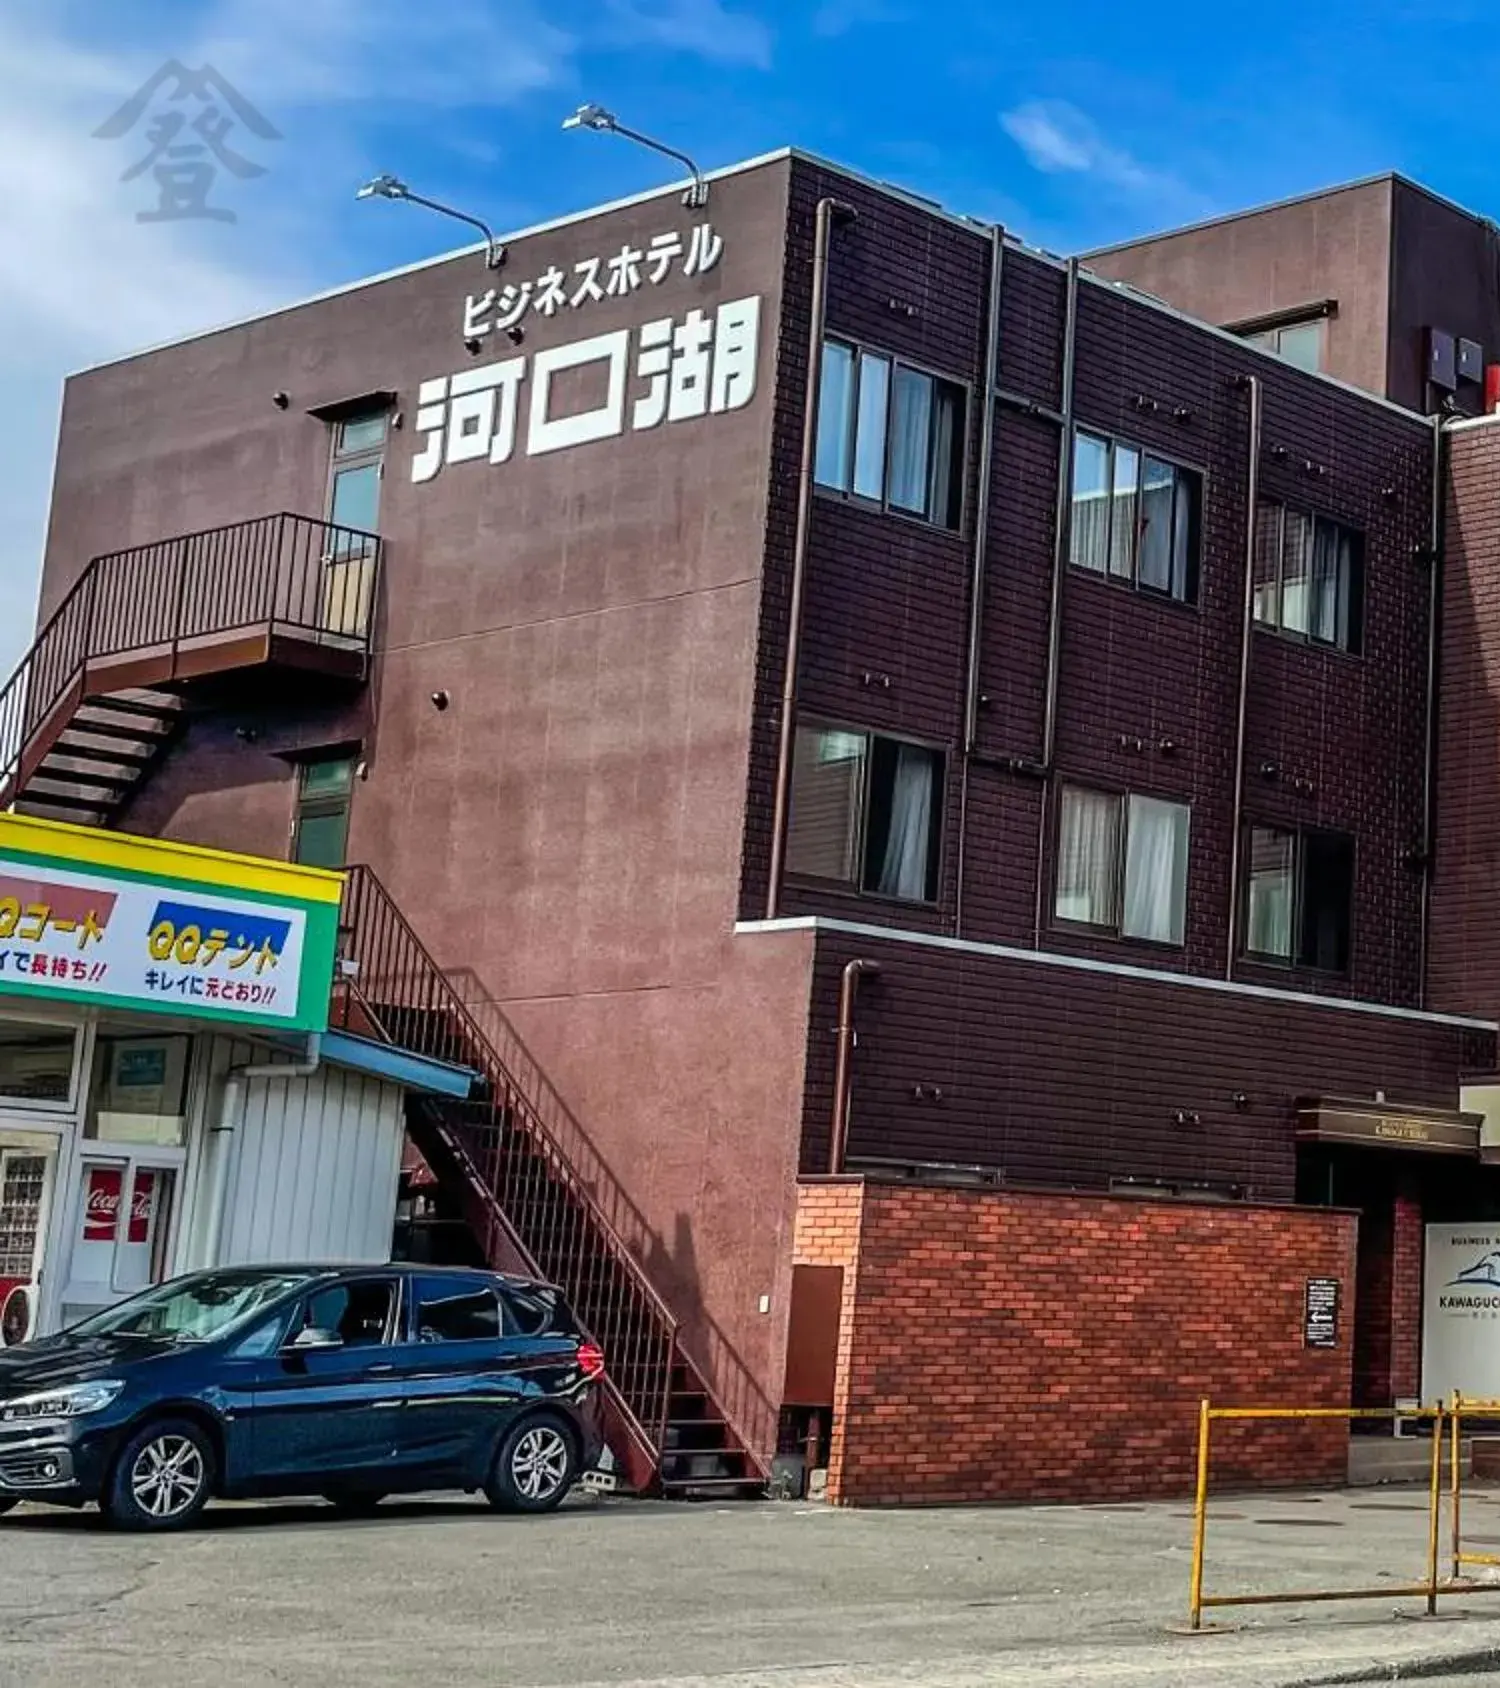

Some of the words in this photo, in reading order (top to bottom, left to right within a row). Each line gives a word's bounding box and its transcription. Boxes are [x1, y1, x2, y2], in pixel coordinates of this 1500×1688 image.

[464, 223, 723, 338] ビジネスホテル
[411, 295, 760, 483] 河口湖
